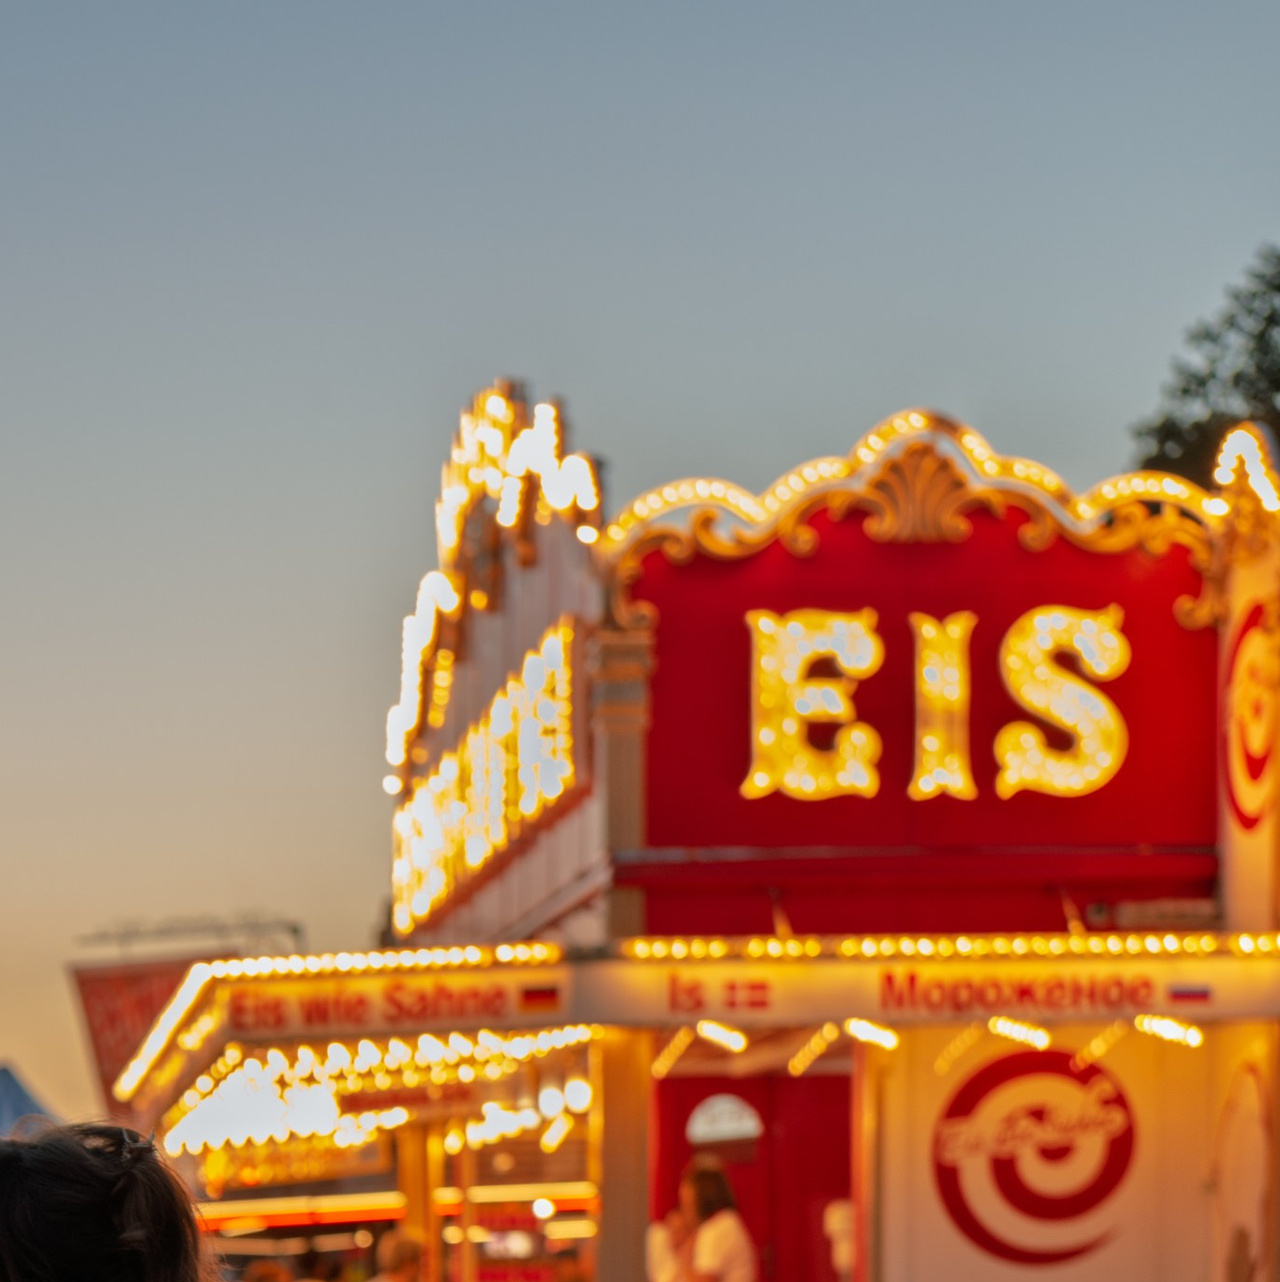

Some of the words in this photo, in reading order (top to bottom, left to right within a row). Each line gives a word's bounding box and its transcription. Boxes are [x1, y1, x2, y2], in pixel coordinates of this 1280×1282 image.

[740, 604, 1132, 800] EIS
[382, 973, 508, 1024] Sahne
[880, 970, 1154, 1015] Мороженое
